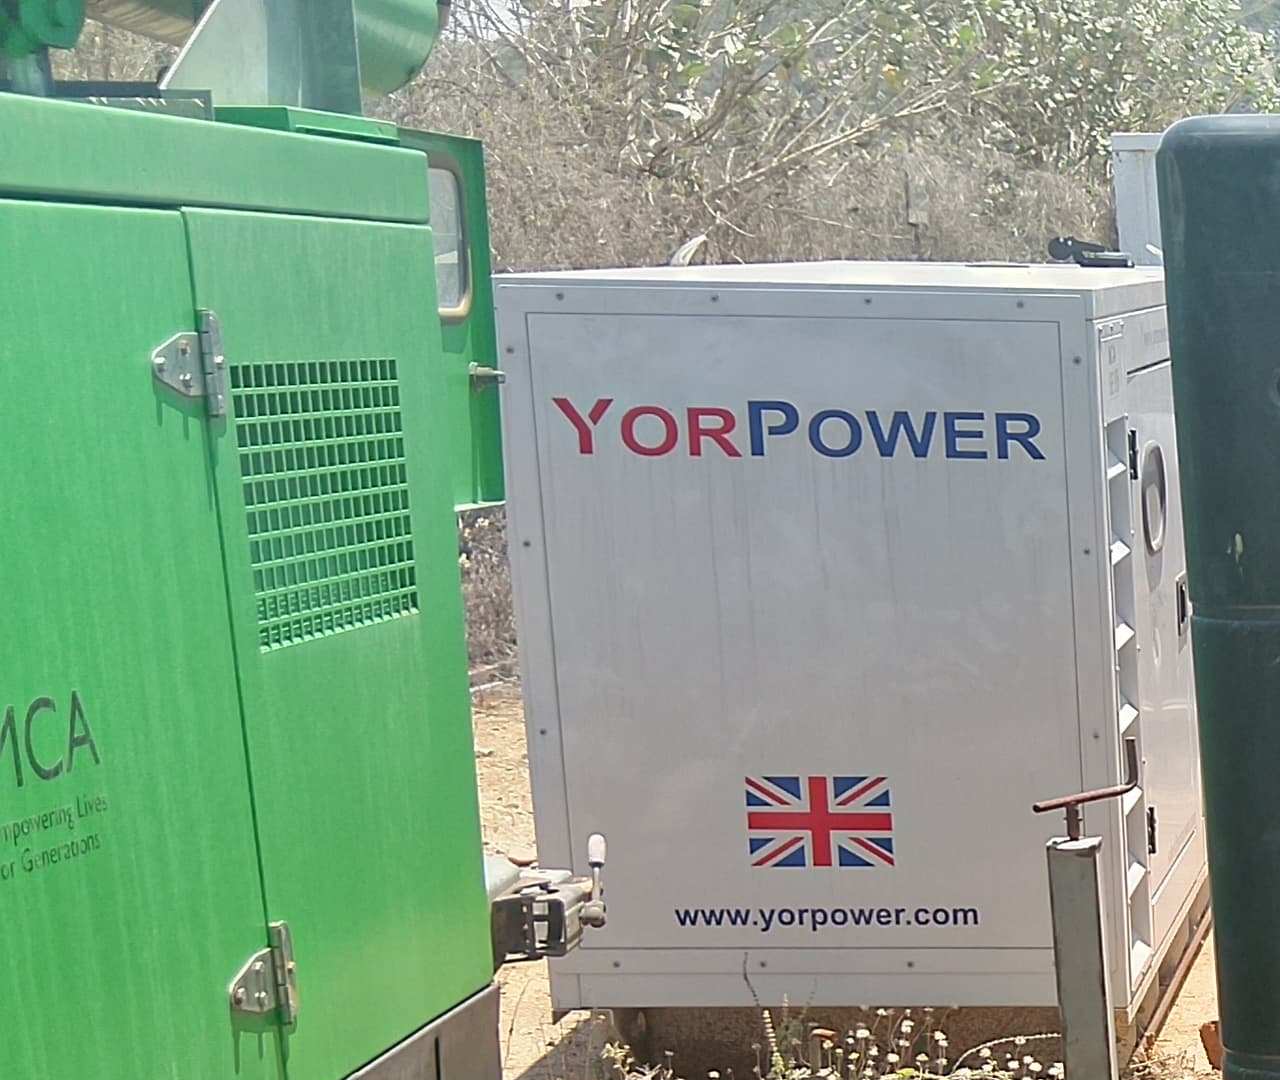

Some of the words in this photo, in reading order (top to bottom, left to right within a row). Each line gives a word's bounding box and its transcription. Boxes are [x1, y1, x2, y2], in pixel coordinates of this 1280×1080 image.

[76, 793, 109, 818] Lives
[21, 832, 101, 873] Generations
[675, 906, 979, 932] www.yorpower.com
